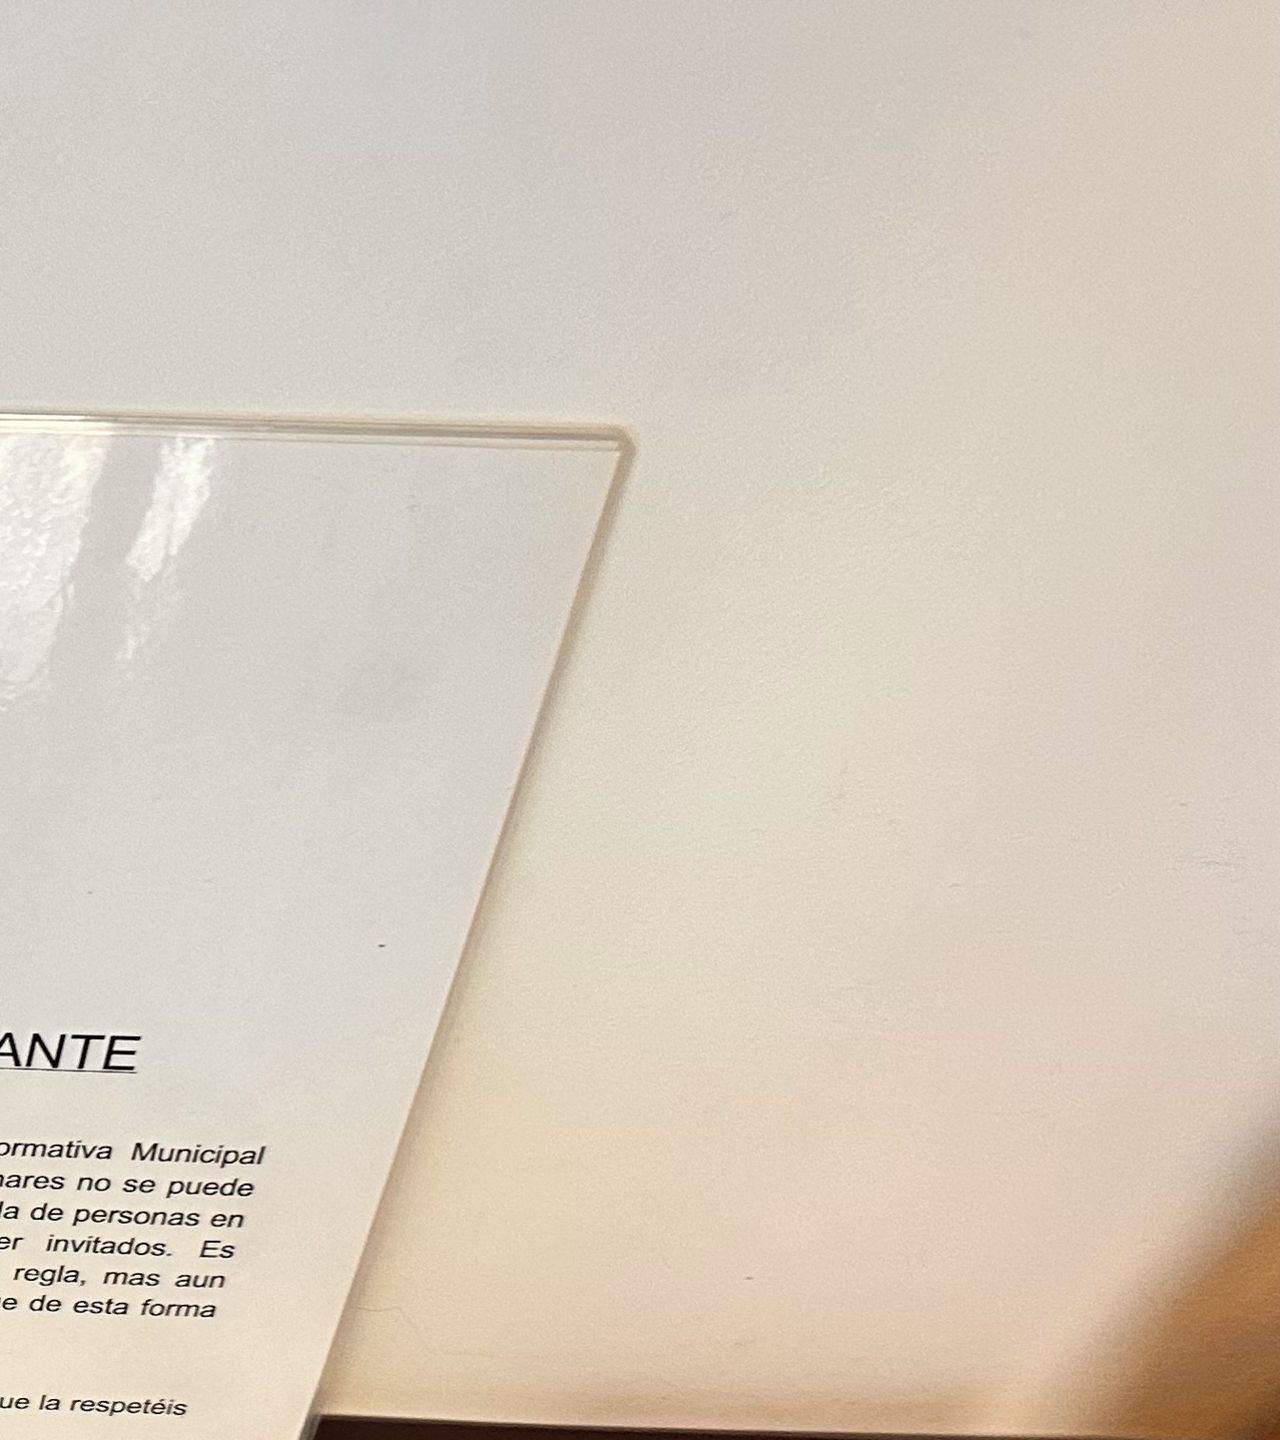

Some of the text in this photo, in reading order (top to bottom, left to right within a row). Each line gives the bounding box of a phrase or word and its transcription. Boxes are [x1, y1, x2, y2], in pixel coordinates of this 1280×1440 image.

[131, 1142, 266, 1170] Municipal
[77, 1176, 112, 1193] no
[122, 1178, 156, 1195] se
[166, 1178, 255, 1200] puede
[29, 1203, 64, 1222] de
[72, 1207, 201, 1228] personas
[210, 1211, 245, 1229] en
[45, 1234, 173, 1258] invitados.
[198, 1240, 236, 1260] Es
[12, 1265, 88, 1288] regla,
[102, 1269, 161, 1288] mas
[174, 1273, 226, 1290] aun
[29, 1295, 63, 1314] de
[72, 1299, 130, 1317] esta
[140, 1299, 218, 1319] forma
[39, 1393, 61, 1412] la
[70, 1396, 189, 1417] respetéis
